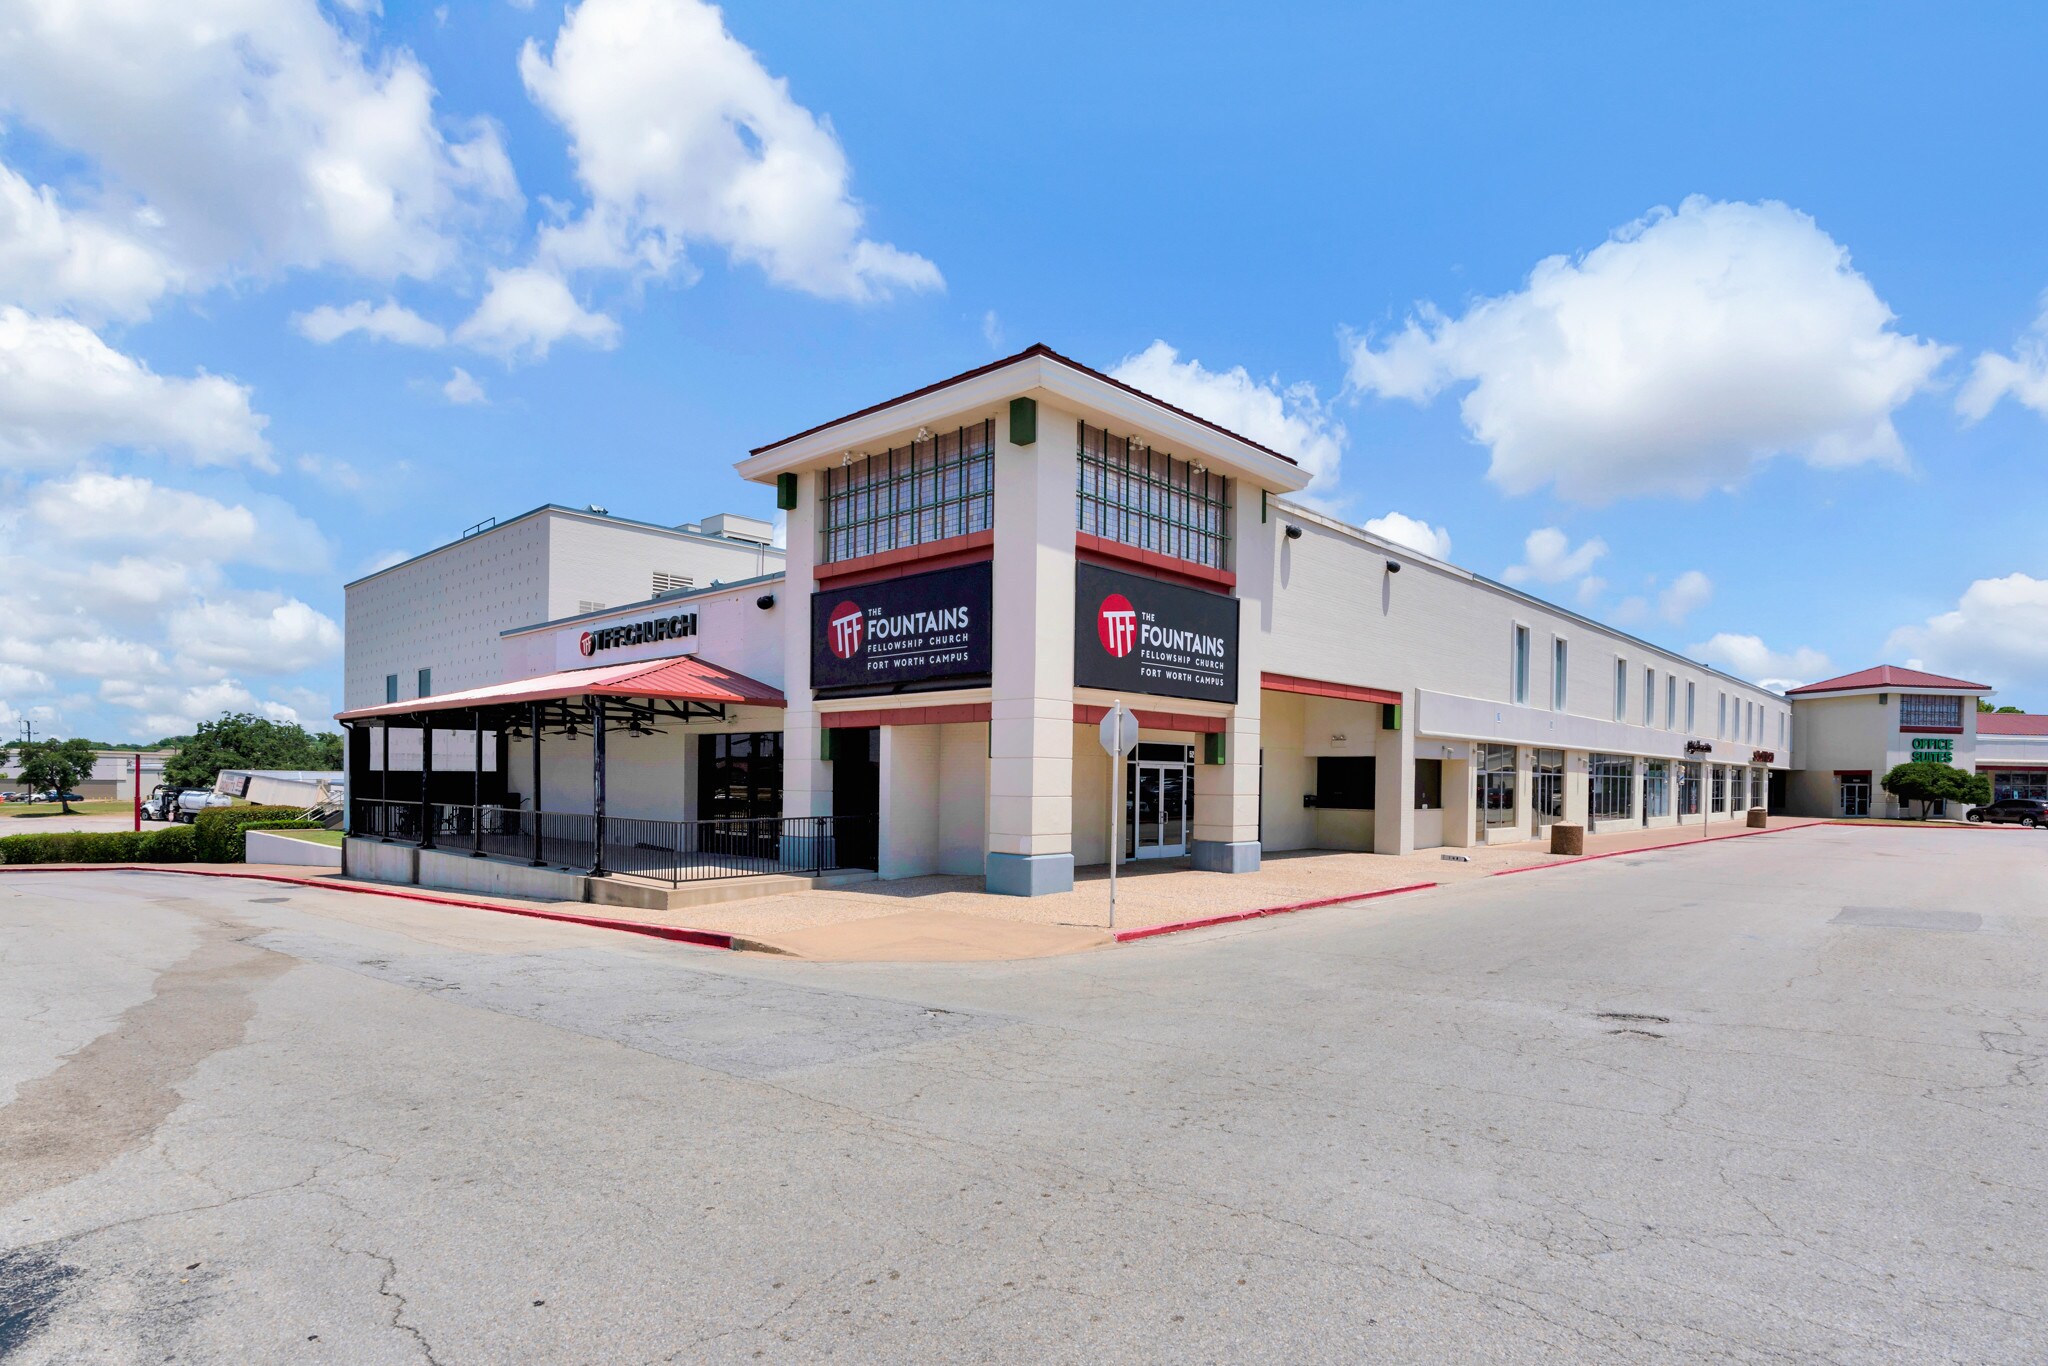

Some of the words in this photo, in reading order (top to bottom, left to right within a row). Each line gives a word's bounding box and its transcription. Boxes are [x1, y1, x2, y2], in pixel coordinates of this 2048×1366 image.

[868, 607, 882, 616] THE
[1141, 611, 1155, 622] THE
[867, 606, 969, 640] FOUNTAINS
[867, 639, 923, 653] FELLOWSHIP
[929, 633, 969, 646] CHURCH
[1141, 624, 1225, 658] FOUNTAINS
[867, 661, 889, 670] FORT
[893, 657, 925, 668] WORTH
[929, 652, 969, 664] CAMPUS
[1140, 649, 1191, 664] FELLOWSHIP
[1195, 658, 1224, 670] CHURCH
[1140, 668, 1162, 677] FORT
[1165, 671, 1192, 682] WORTH
[1195, 675, 1224, 686] CAMPUS
[1912, 738, 1953, 750] OFFICE
[1912, 751, 1953, 762] SUITES
